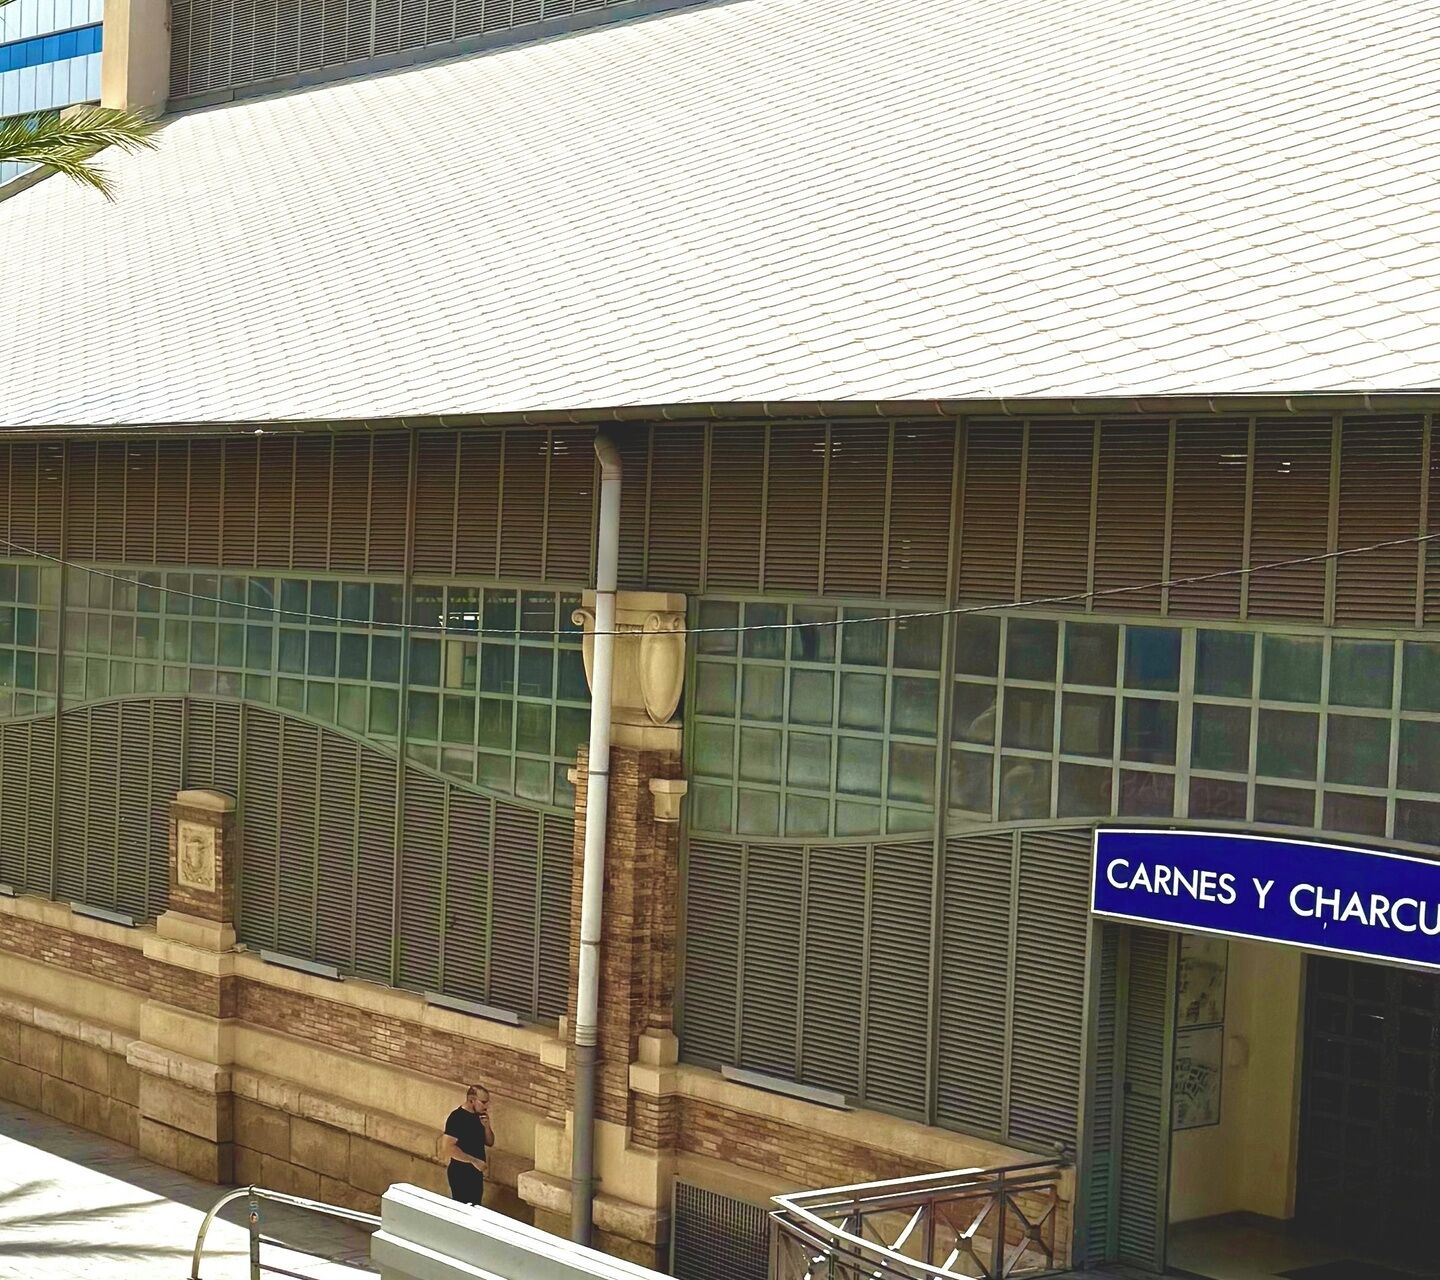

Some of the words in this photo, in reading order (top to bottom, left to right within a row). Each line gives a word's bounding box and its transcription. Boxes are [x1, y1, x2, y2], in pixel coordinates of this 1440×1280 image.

[1106, 858, 1237, 905] CARNES
[1252, 878, 1275, 909] Y
[1288, 883, 1440, 936] CHARCU
